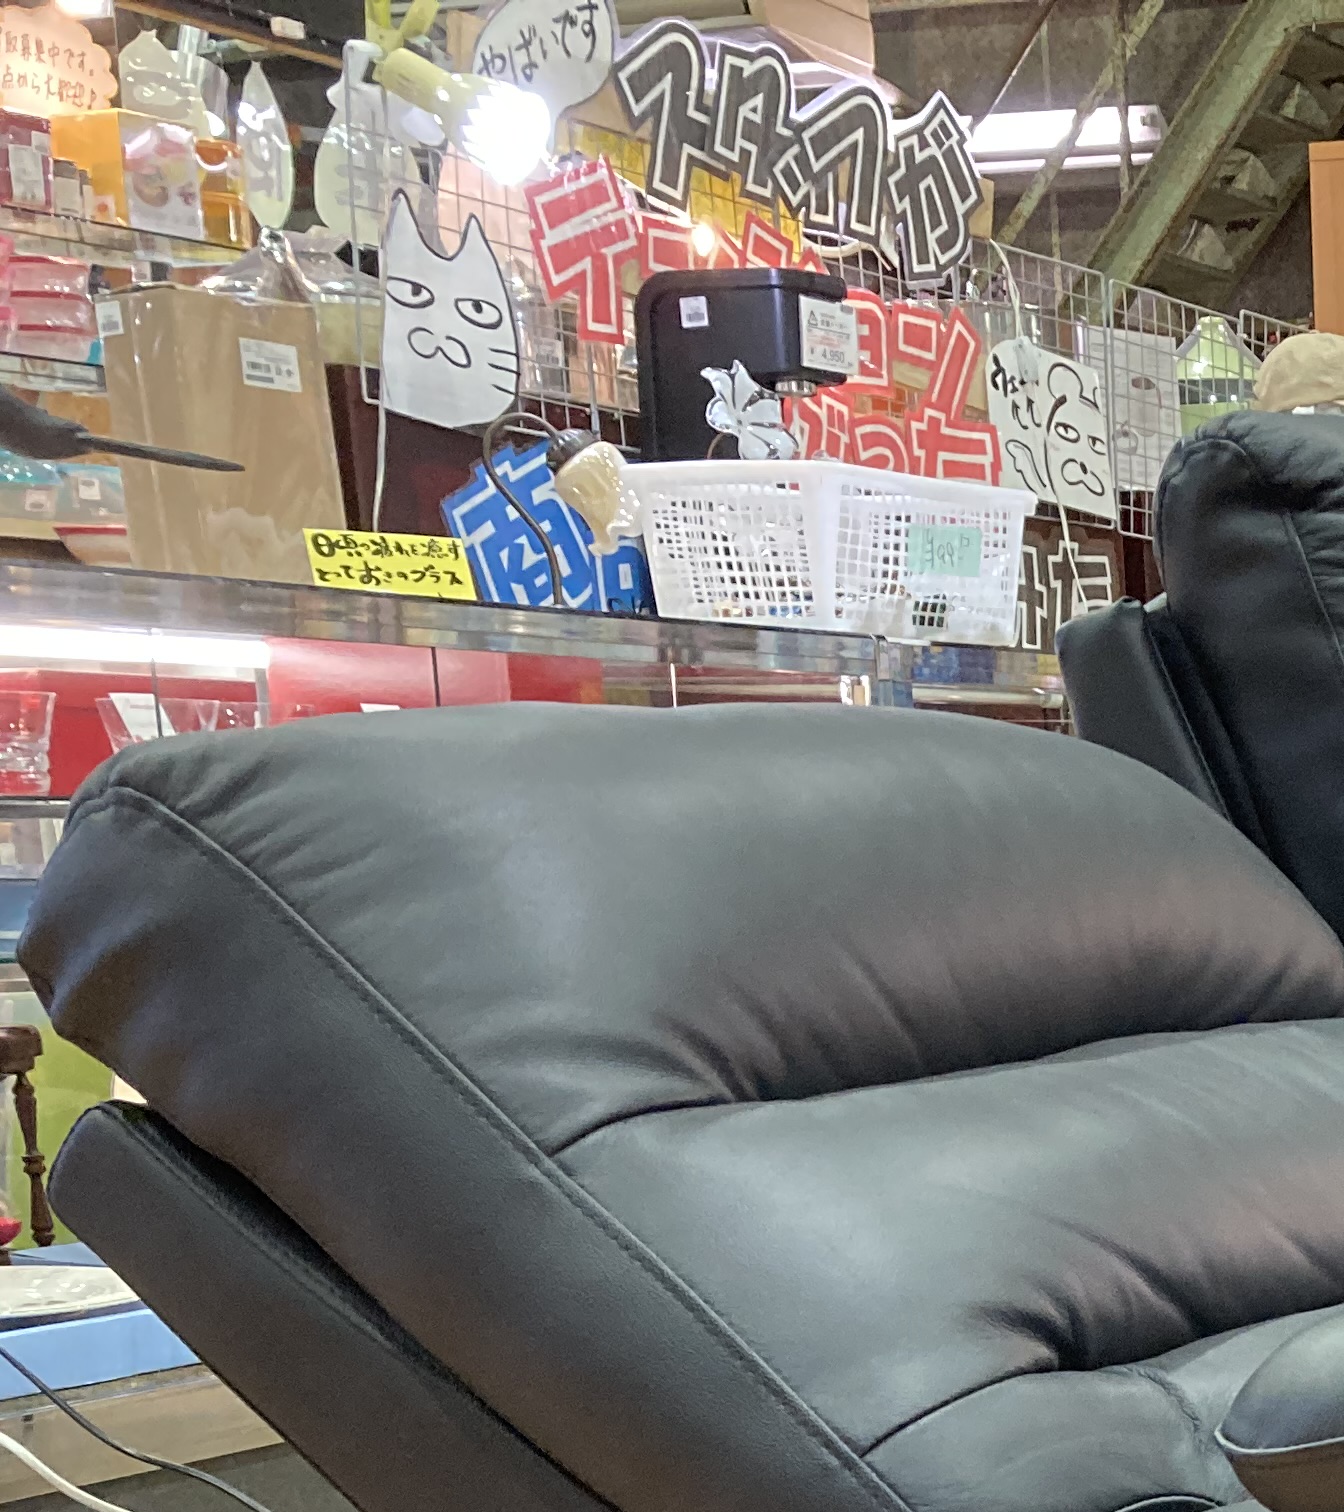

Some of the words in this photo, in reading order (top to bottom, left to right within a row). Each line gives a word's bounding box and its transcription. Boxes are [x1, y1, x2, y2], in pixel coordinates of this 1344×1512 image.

[610, 18, 986, 290] スタッフが
